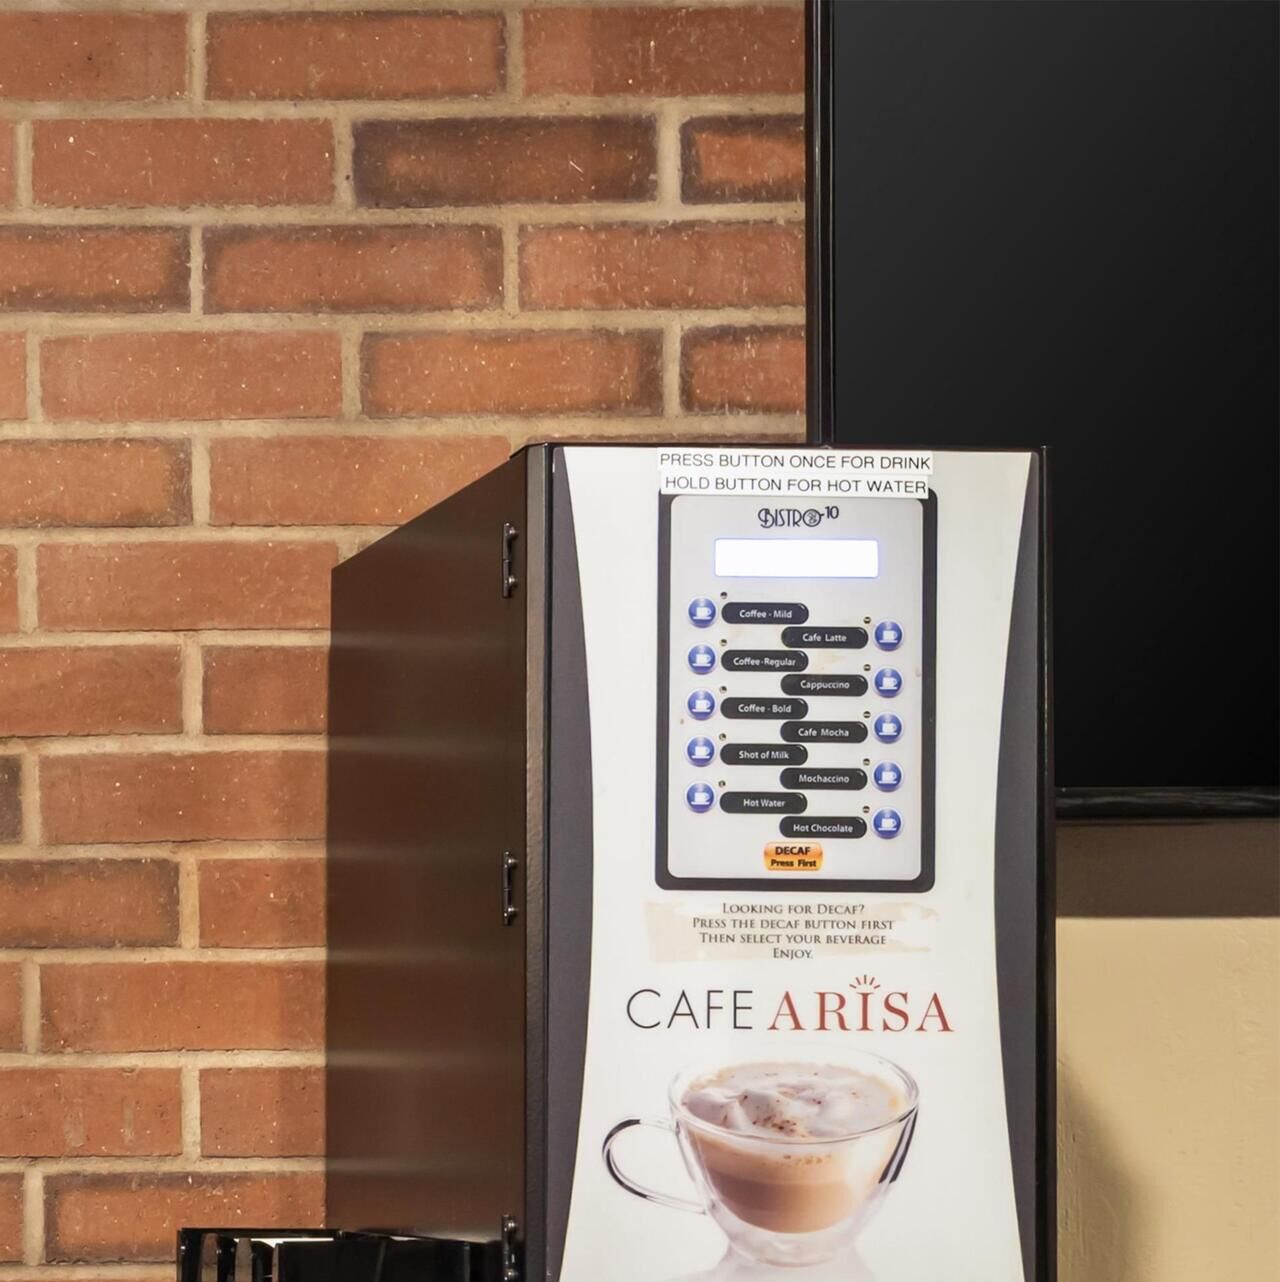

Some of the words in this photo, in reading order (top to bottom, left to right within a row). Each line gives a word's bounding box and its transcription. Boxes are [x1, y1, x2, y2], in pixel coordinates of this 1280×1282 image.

[659, 453, 714, 467] PRESS
[719, 454, 785, 468] BUTTON
[789, 455, 836, 469] ONCE
[841, 455, 875, 469] FOR
[879, 456, 931, 470] DRINK
[665, 476, 711, 490] HOLD
[715, 477, 782, 492] BUTTON
[787, 478, 822, 492] FOR
[827, 479, 862, 493] HOT
[866, 480, 927, 494] WATER
[739, 608, 767, 618] Coffee
[773, 609, 793, 618] Mild
[802, 633, 822, 642] Cafe
[824, 633, 847, 642] Latte
[800, 680, 850, 691] Cappuccino
[738, 703, 766, 713] Coffee
[772, 704, 792, 713] Bold
[798, 727, 818, 737] Cafe
[821, 727, 850, 737] Mocha
[738, 750, 758, 760] Shot
[760, 750, 770, 760] of
[771, 751, 790, 760] Milk
[798, 774, 850, 784] Mochaccino
[743, 798, 760, 808] Hot
[760, 798, 786, 808] Water
[793, 824, 809, 833] Hot
[810, 823, 854, 833] Chocolate
[775, 846, 811, 856] DECAF
[770, 859, 794, 868] Press
[797, 859, 817, 868] First
[626, 988, 753, 1030] CAFE
[767, 990, 955, 1033] ARISA
